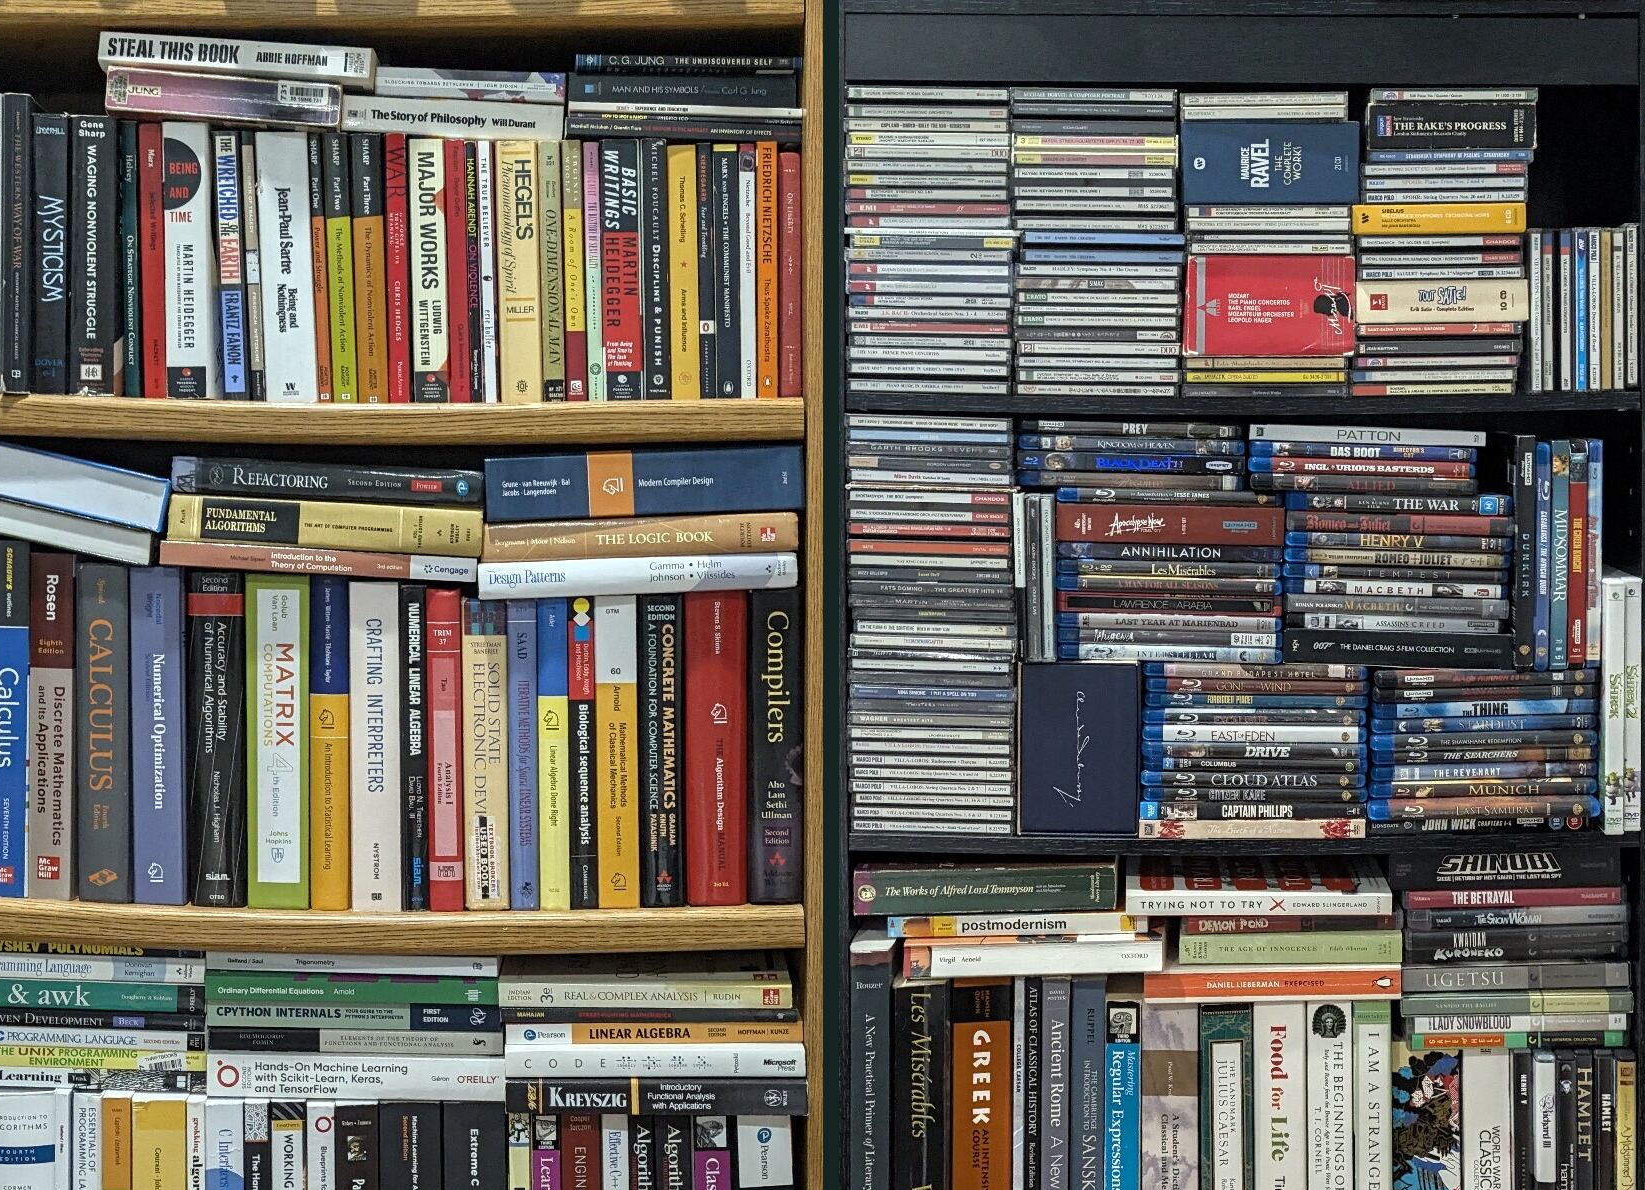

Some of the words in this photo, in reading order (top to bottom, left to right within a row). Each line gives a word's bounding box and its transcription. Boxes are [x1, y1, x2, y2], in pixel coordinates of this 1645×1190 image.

[108, 38, 155, 60] STEAL
[161, 41, 193, 61] THIS
[197, 44, 239, 63] BOOK
[1394, 122, 1416, 130] THE
[1419, 122, 1452, 130] RAKE'S
[1455, 122, 1506, 130] PROGRESS
[1241, 147, 1250, 180] MAURICE
[1251, 139, 1269, 187] RAVEL
[515, 160, 533, 241] HEGEL'S
[507, 306, 535, 314] MILLER
[1337, 430, 1400, 442] PATTON
[1331, 447, 1351, 458] DAS
[1354, 447, 1380, 458] BOOT
[232, 470, 328, 488] REFACTORING
[205, 518, 265, 532] ALGORITHMS
[1122, 547, 1221, 558] ANNIHILATION
[434, 566, 468, 575] Cengage
[1355, 586, 1424, 596] MACBETH
[762, 610, 789, 744] Compilers
[1212, 774, 1268, 786] CLOUD
[1273, 775, 1317, 786] ATLAS
[962, 919, 1067, 930] postmodernism
[1425, 972, 1504, 986] UGETSU
[7, 984, 29, 1004] &
[37, 985, 90, 1006] awk
[589, 1028, 632, 1039] LINEAR
[636, 1027, 691, 1038] ALGEBRA
[1270, 1025, 1287, 1080] Food
[972, 1030, 990, 1123] GREEK
[549, 1086, 627, 1108] KREYSZIG
[1271, 1087, 1281, 1111] for
[1270, 1116, 1288, 1162] Life
